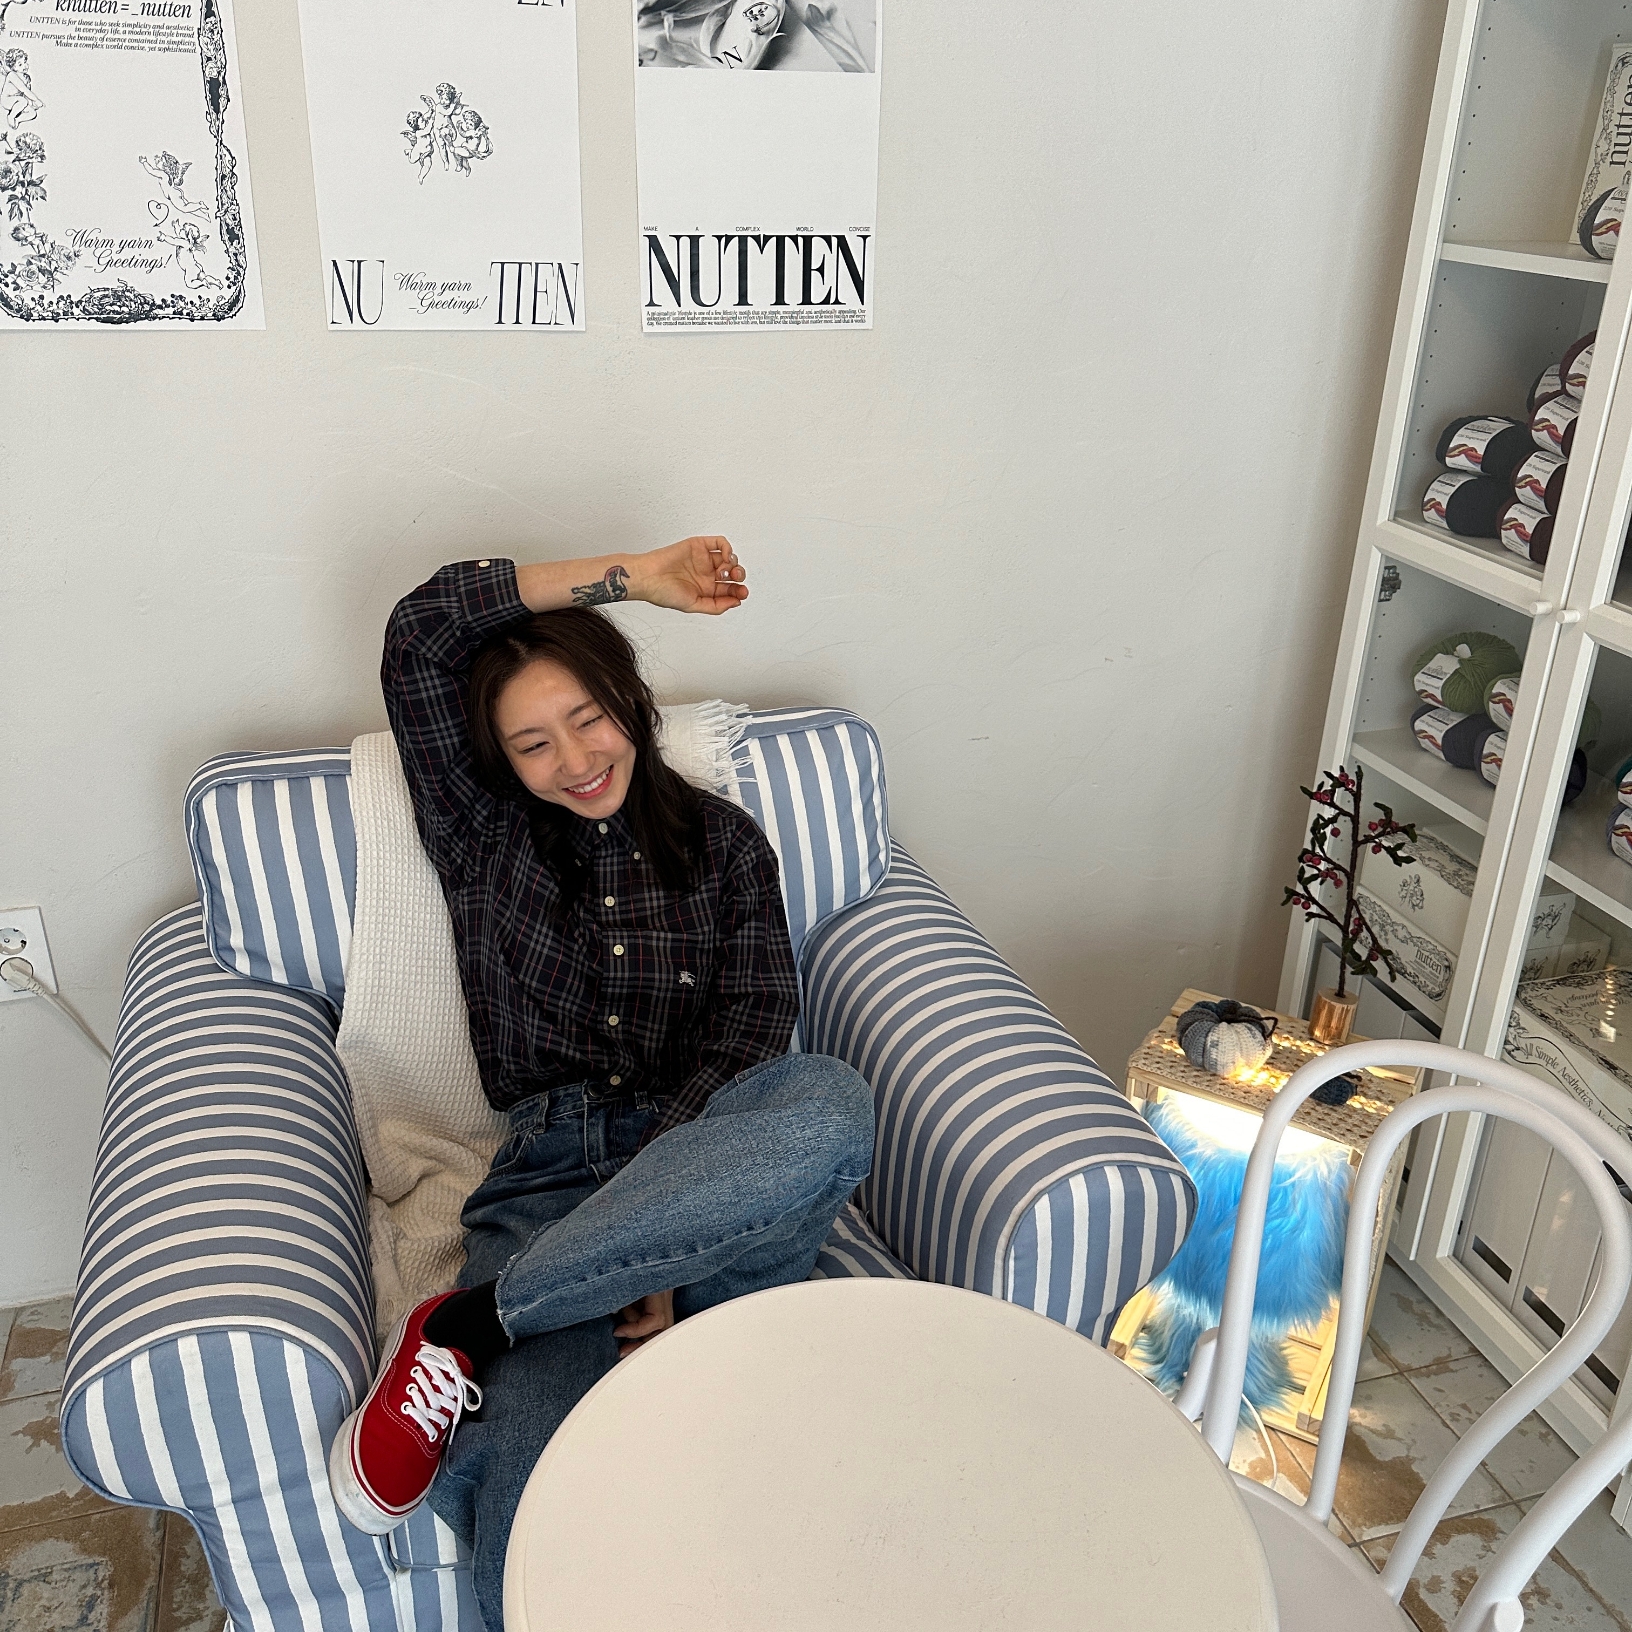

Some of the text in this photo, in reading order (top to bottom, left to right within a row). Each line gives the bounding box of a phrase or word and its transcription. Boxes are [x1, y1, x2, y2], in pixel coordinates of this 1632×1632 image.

[66, 18, 77, 26] for
[121, 21, 152, 30] simplicity
[82, 27, 109, 35] everyday
[152, 30, 175, 38] lifestyle
[55, 40, 73, 48] Make
[79, 42, 105, 50] complex
[77, 34, 98, 42] beauty
[65, 228, 154, 254] Warm yarn
[643, 234, 872, 308] NUTTEN
[330, 259, 385, 326] NU
[393, 272, 472, 297] Warm yarn
[489, 261, 580, 326] TTEN
[1415, 949, 1442, 976] nutten
[1535, 1045, 1560, 1069] Simple
